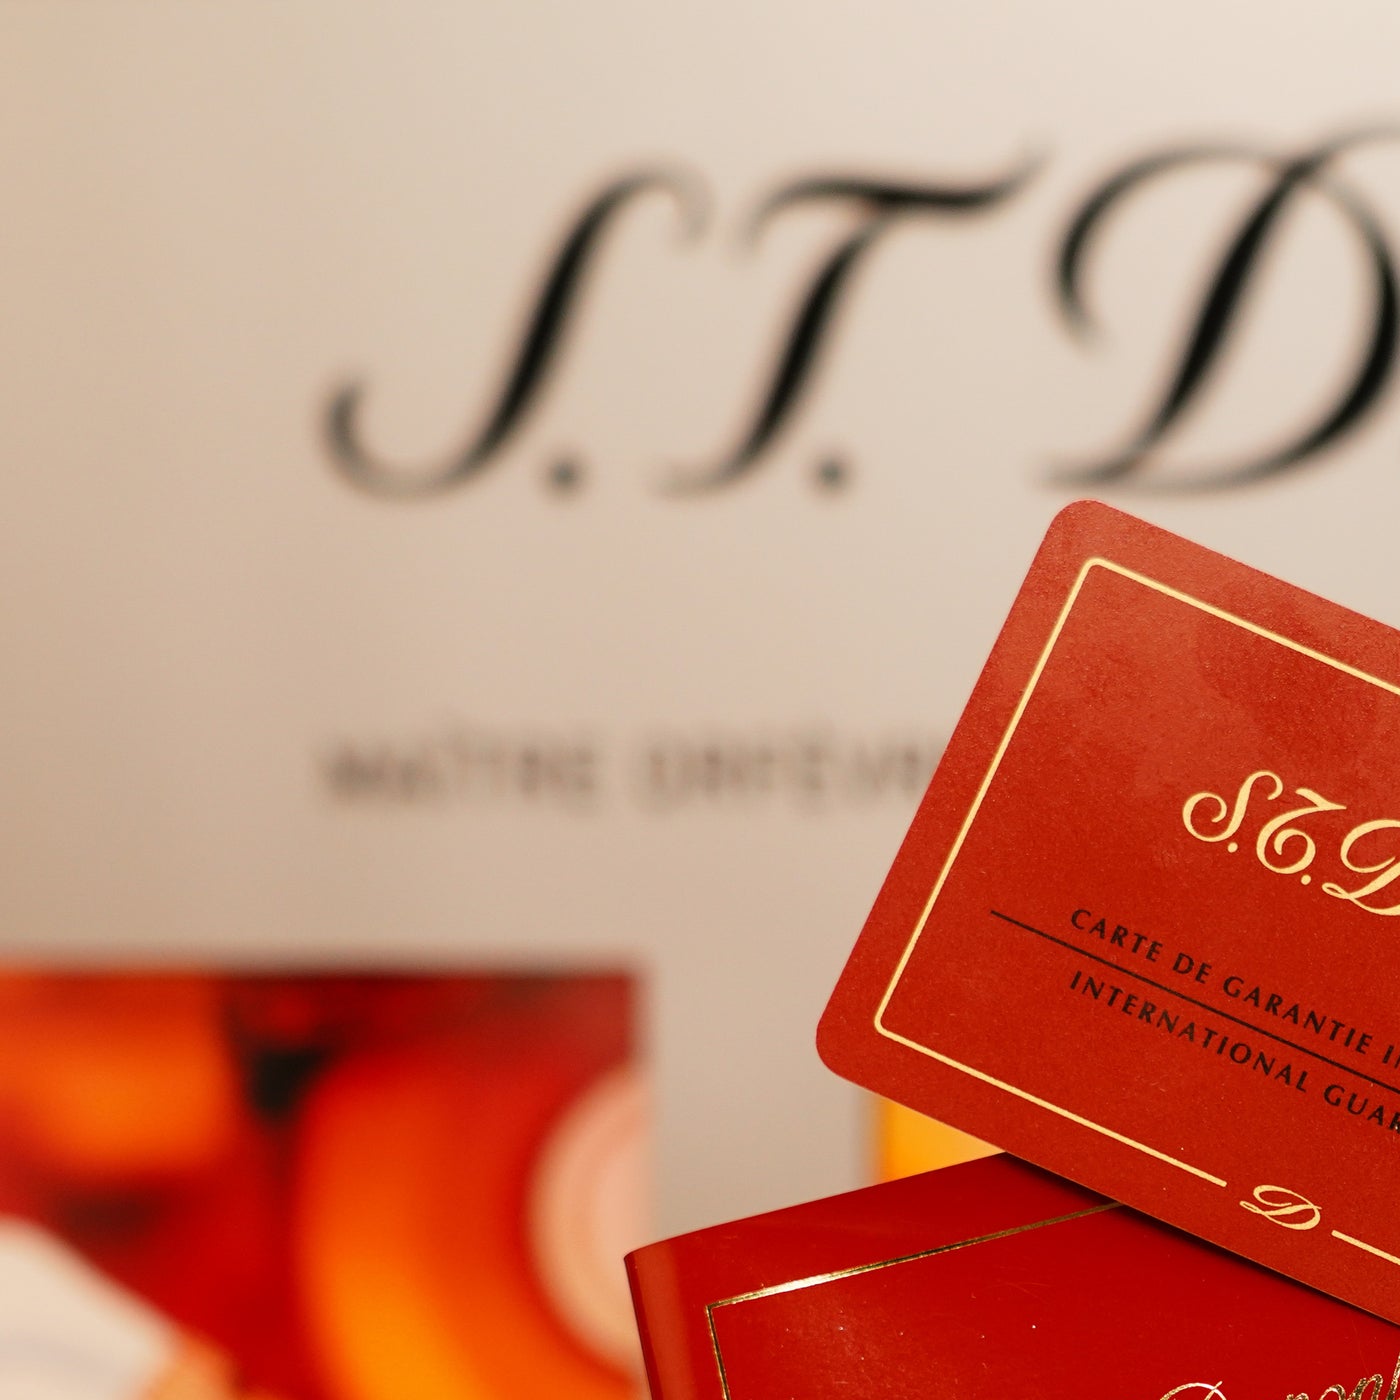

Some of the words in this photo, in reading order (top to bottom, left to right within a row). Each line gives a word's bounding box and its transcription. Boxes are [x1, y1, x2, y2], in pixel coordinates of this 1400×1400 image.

[322, 145, 1046, 503] S.T.
[1181, 770, 1348, 886] S.T.
[1069, 907, 1164, 963] CARTE
[1171, 951, 1213, 985] DE
[1221, 975, 1374, 1056] GARANTIE
[1069, 969, 1310, 1094] INTERNATIONAL
